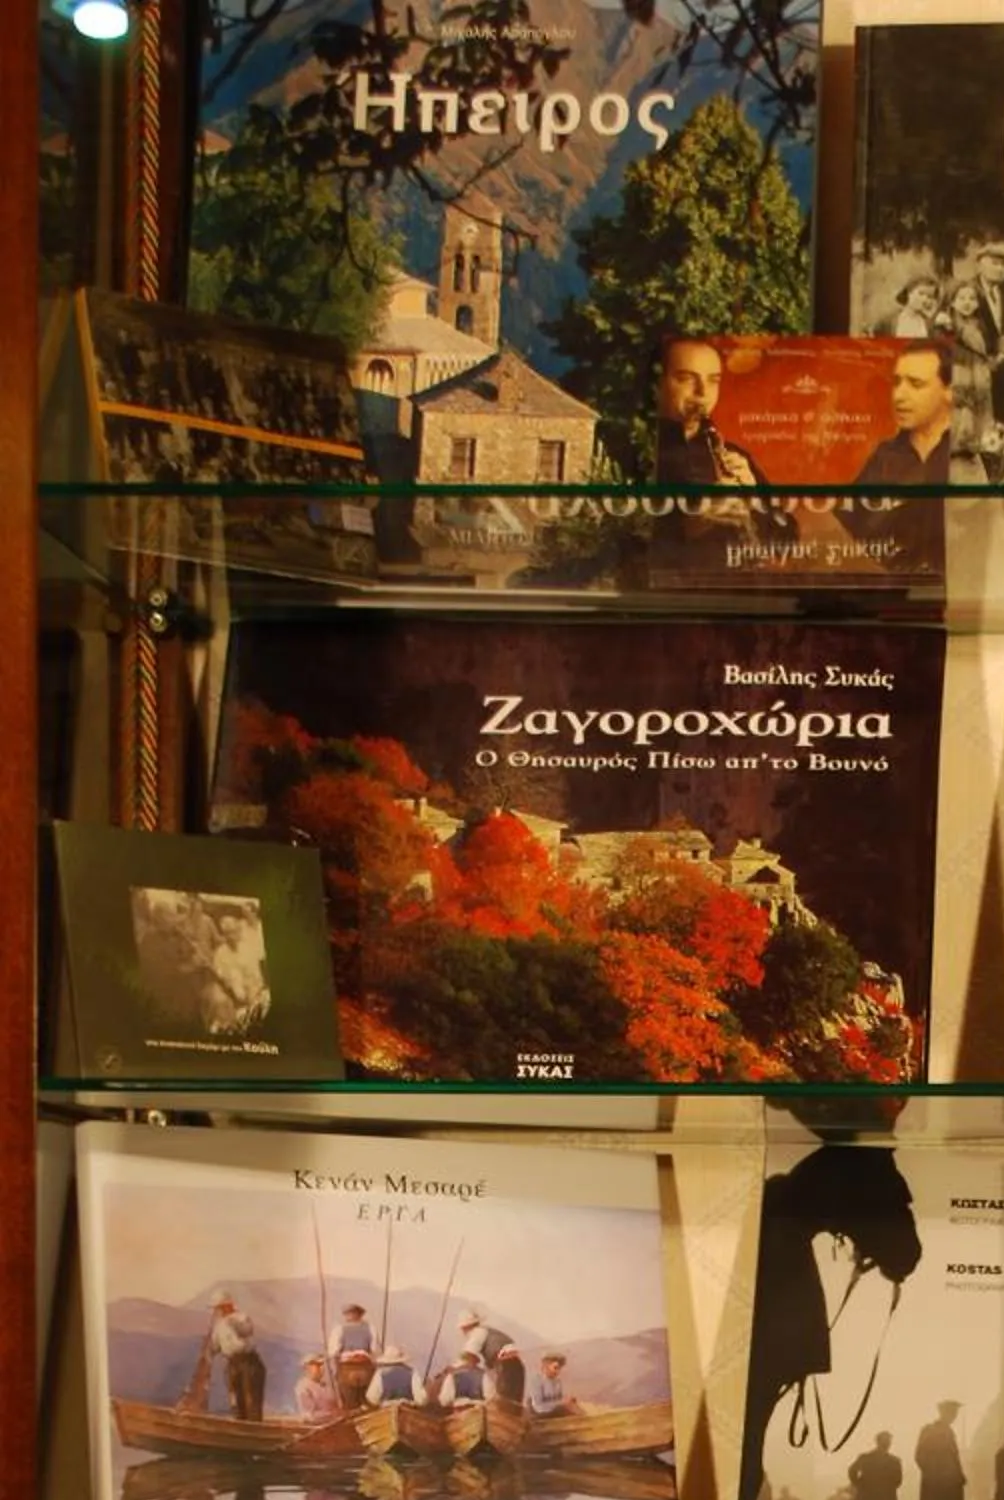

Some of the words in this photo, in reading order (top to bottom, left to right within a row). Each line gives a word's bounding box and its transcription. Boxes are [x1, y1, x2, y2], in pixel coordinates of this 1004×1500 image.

[724, 664, 817, 689] Βασίλης
[824, 664, 895, 690] Συκάς
[480, 695, 894, 747] Ζαγοροχώρια
[475, 751, 498, 768] Ο
[508, 751, 637, 772] Θησαυρός
[648, 751, 717, 769] Πίσω
[809, 752, 889, 772] Βουνό
[517, 1053, 575, 1064] ΕΚΔΟΣΕΙΣ
[516, 1064, 574, 1079] ΣΥΚΑΣ
[293, 1168, 374, 1194] Κενάν
[384, 1173, 488, 1202] Μεσαρέ
[356, 1203, 428, 1223] ΕΡΓΑ
[946, 1264, 1003, 1275] KOSTAS
